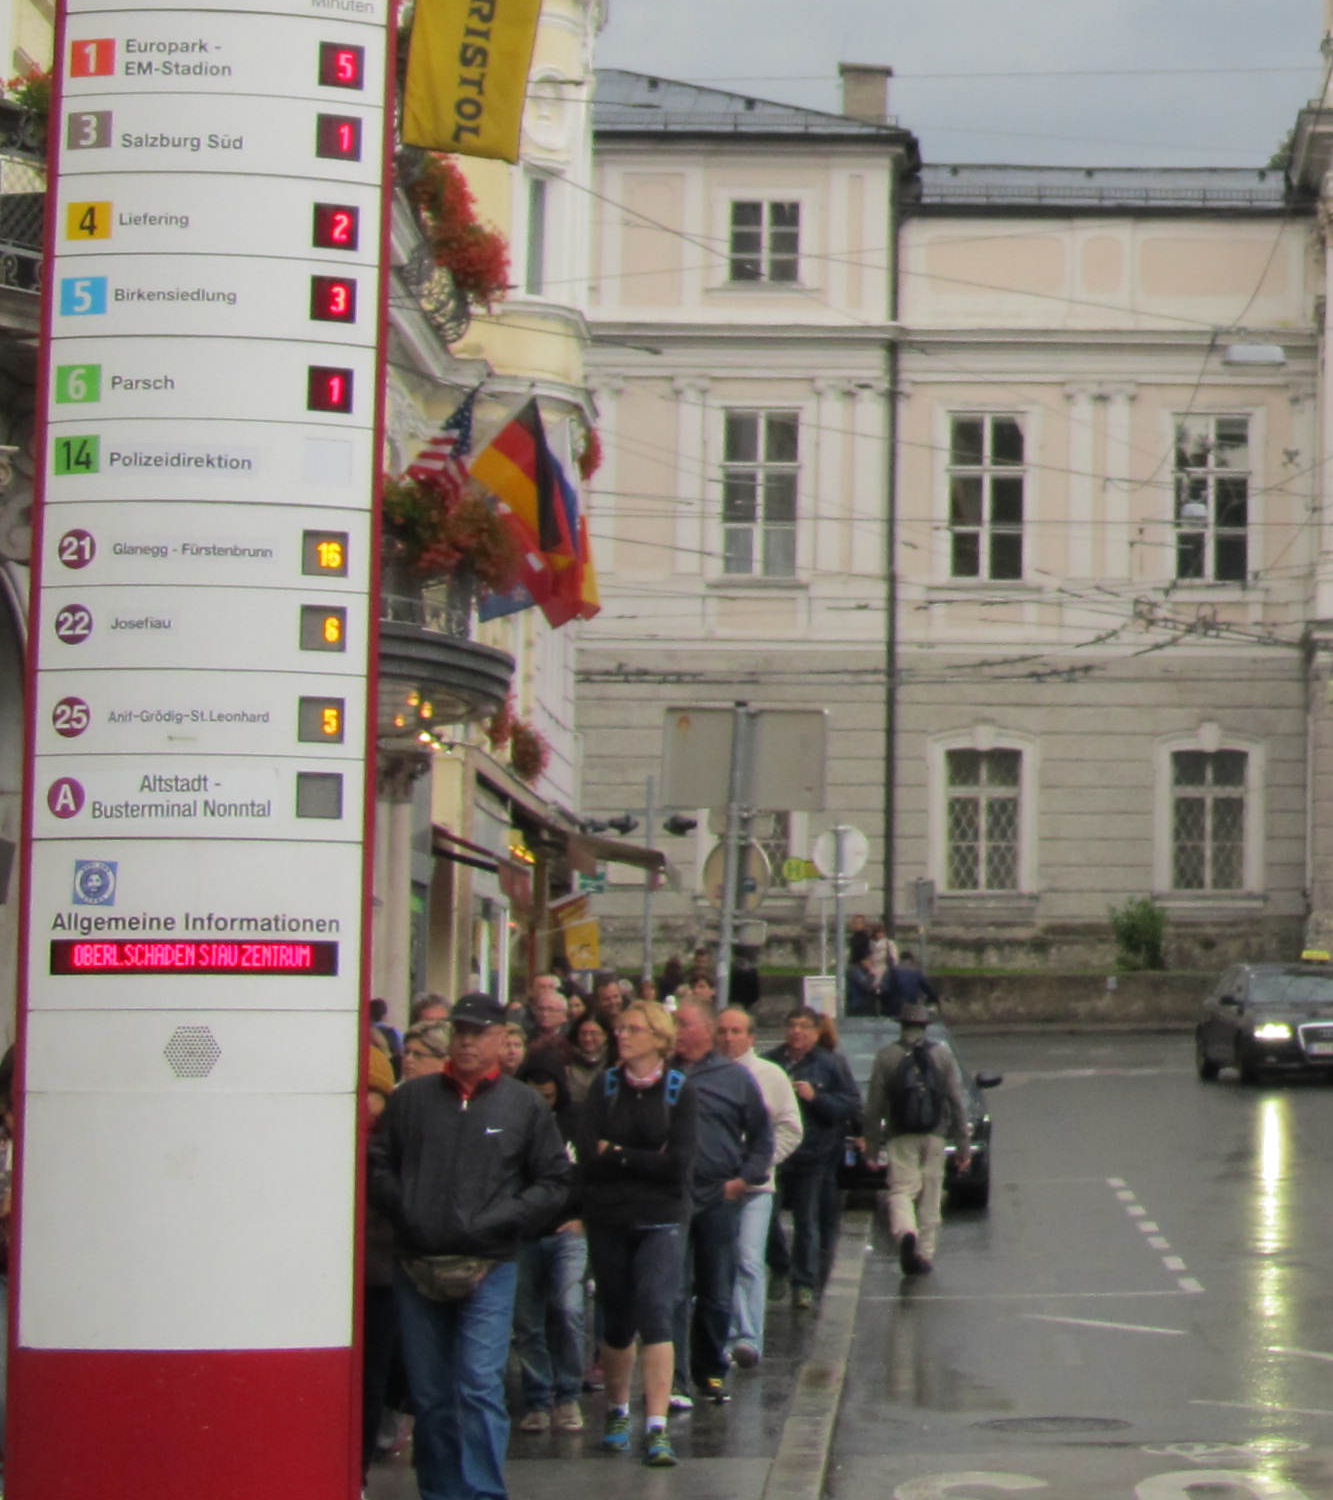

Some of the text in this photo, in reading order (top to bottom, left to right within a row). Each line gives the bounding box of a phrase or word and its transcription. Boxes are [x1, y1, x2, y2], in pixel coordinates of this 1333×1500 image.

[83, 43, 97, 74] 1
[126, 38, 208, 54] Europark
[124, 60, 232, 77] EM-Stadion
[338, 53, 353, 80] 5
[78, 114, 98, 147] 3
[121, 133, 243, 151] Salzburg Süd
[339, 124, 349, 151] 1
[78, 205, 98, 236] 4
[118, 212, 189, 229] Liefering
[332, 213, 349, 242] 2
[72, 280, 92, 313] 5
[113, 287, 237, 305] Birkensiedlung
[329, 286, 346, 314] 3
[67, 368, 87, 400] 6
[111, 375, 175, 390] Parsch
[329, 376, 341, 404] 1
[62, 439, 93, 471] 14
[109, 451, 252, 471] Polizeidirektion
[61, 536, 93, 562] 21
[112, 542, 168, 558] Glanegg
[181, 542, 273, 559] Fürstenbrunn
[316, 541, 343, 569] 16
[58, 610, 90, 636] 22
[110, 616, 172, 630] Josefiau
[54, 704, 88, 730] 25
[322, 708, 339, 735] 5
[139, 774, 209, 793] Altstadt
[54, 783, 77, 812] A
[91, 800, 272, 819] Busterminal Nonntal
[51, 912, 341, 935] Allgemeine Informationen
[198, 943, 239, 968] STAU
[241, 944, 312, 969] ZENTRUM
